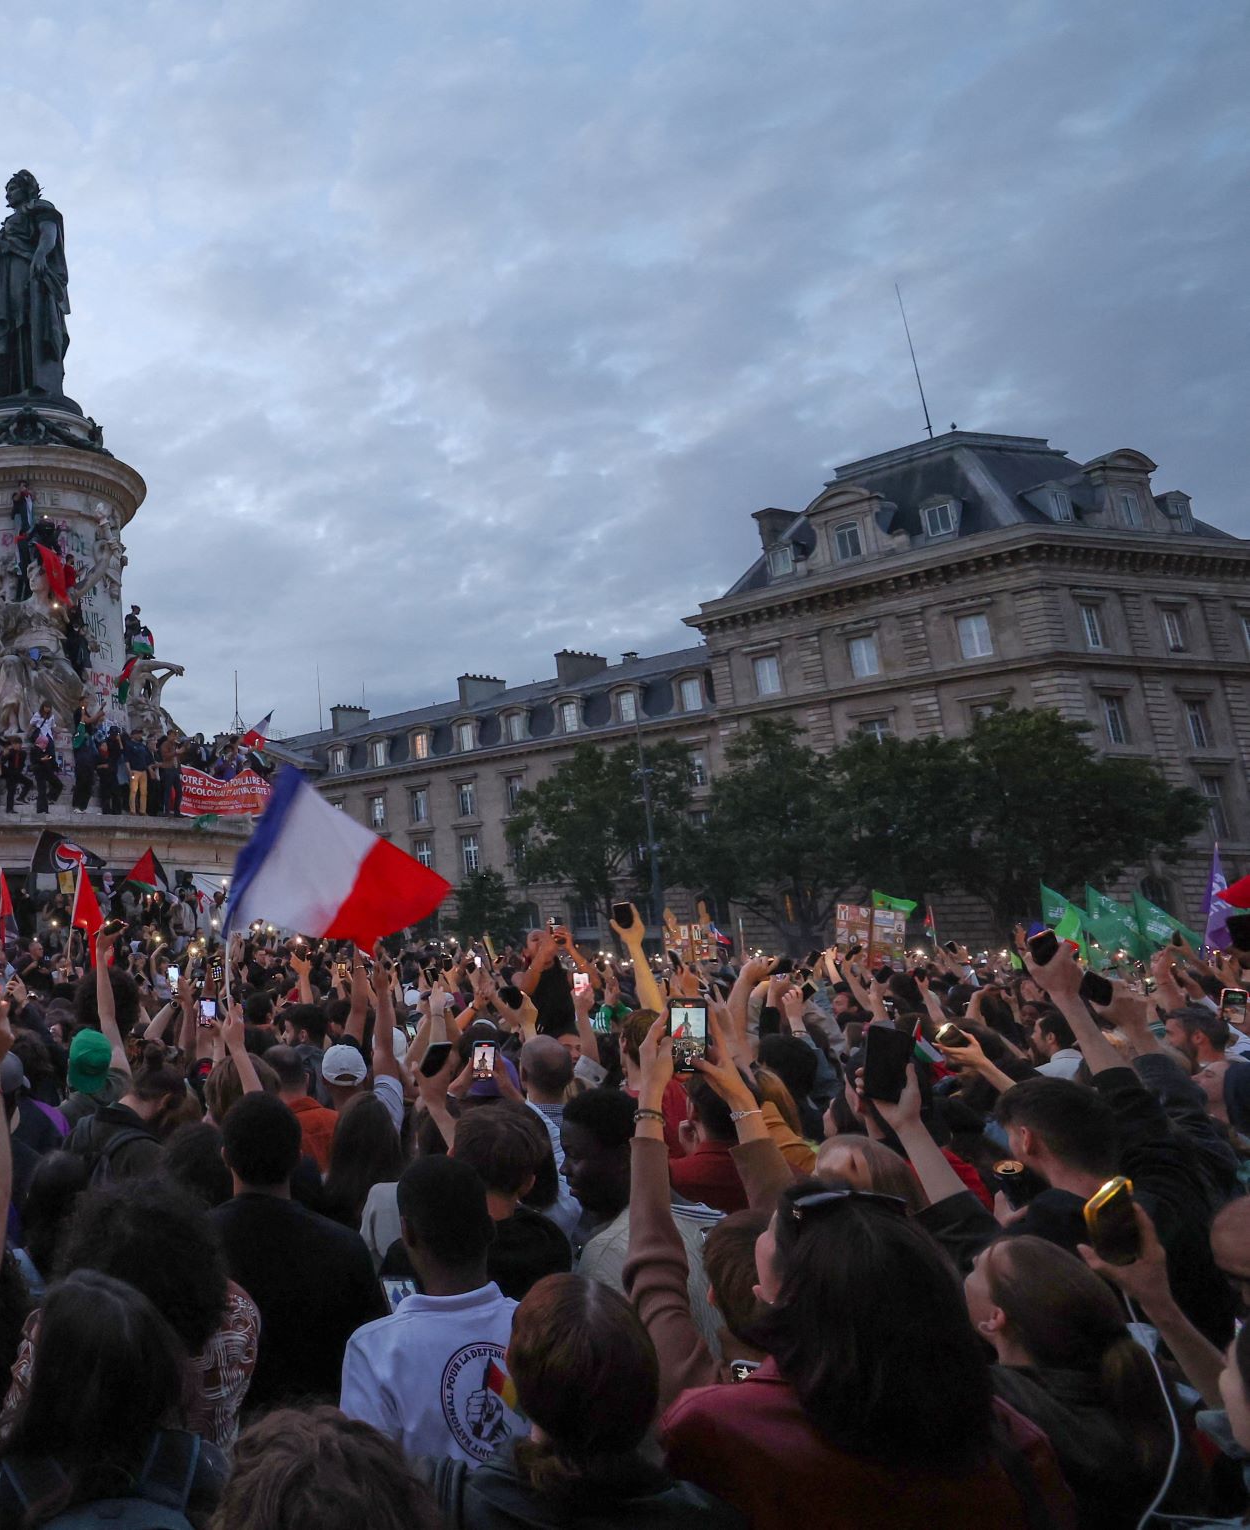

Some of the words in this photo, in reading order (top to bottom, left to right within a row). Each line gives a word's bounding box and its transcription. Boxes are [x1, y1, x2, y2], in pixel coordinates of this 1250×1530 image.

[181, 786, 226, 797] TICOLONIAL
[459, 1353, 472, 1366] LA
[470, 1348, 505, 1361] DEFEN
[446, 1363, 463, 1391] POUR
[446, 1392, 473, 1449] NATIONAL
